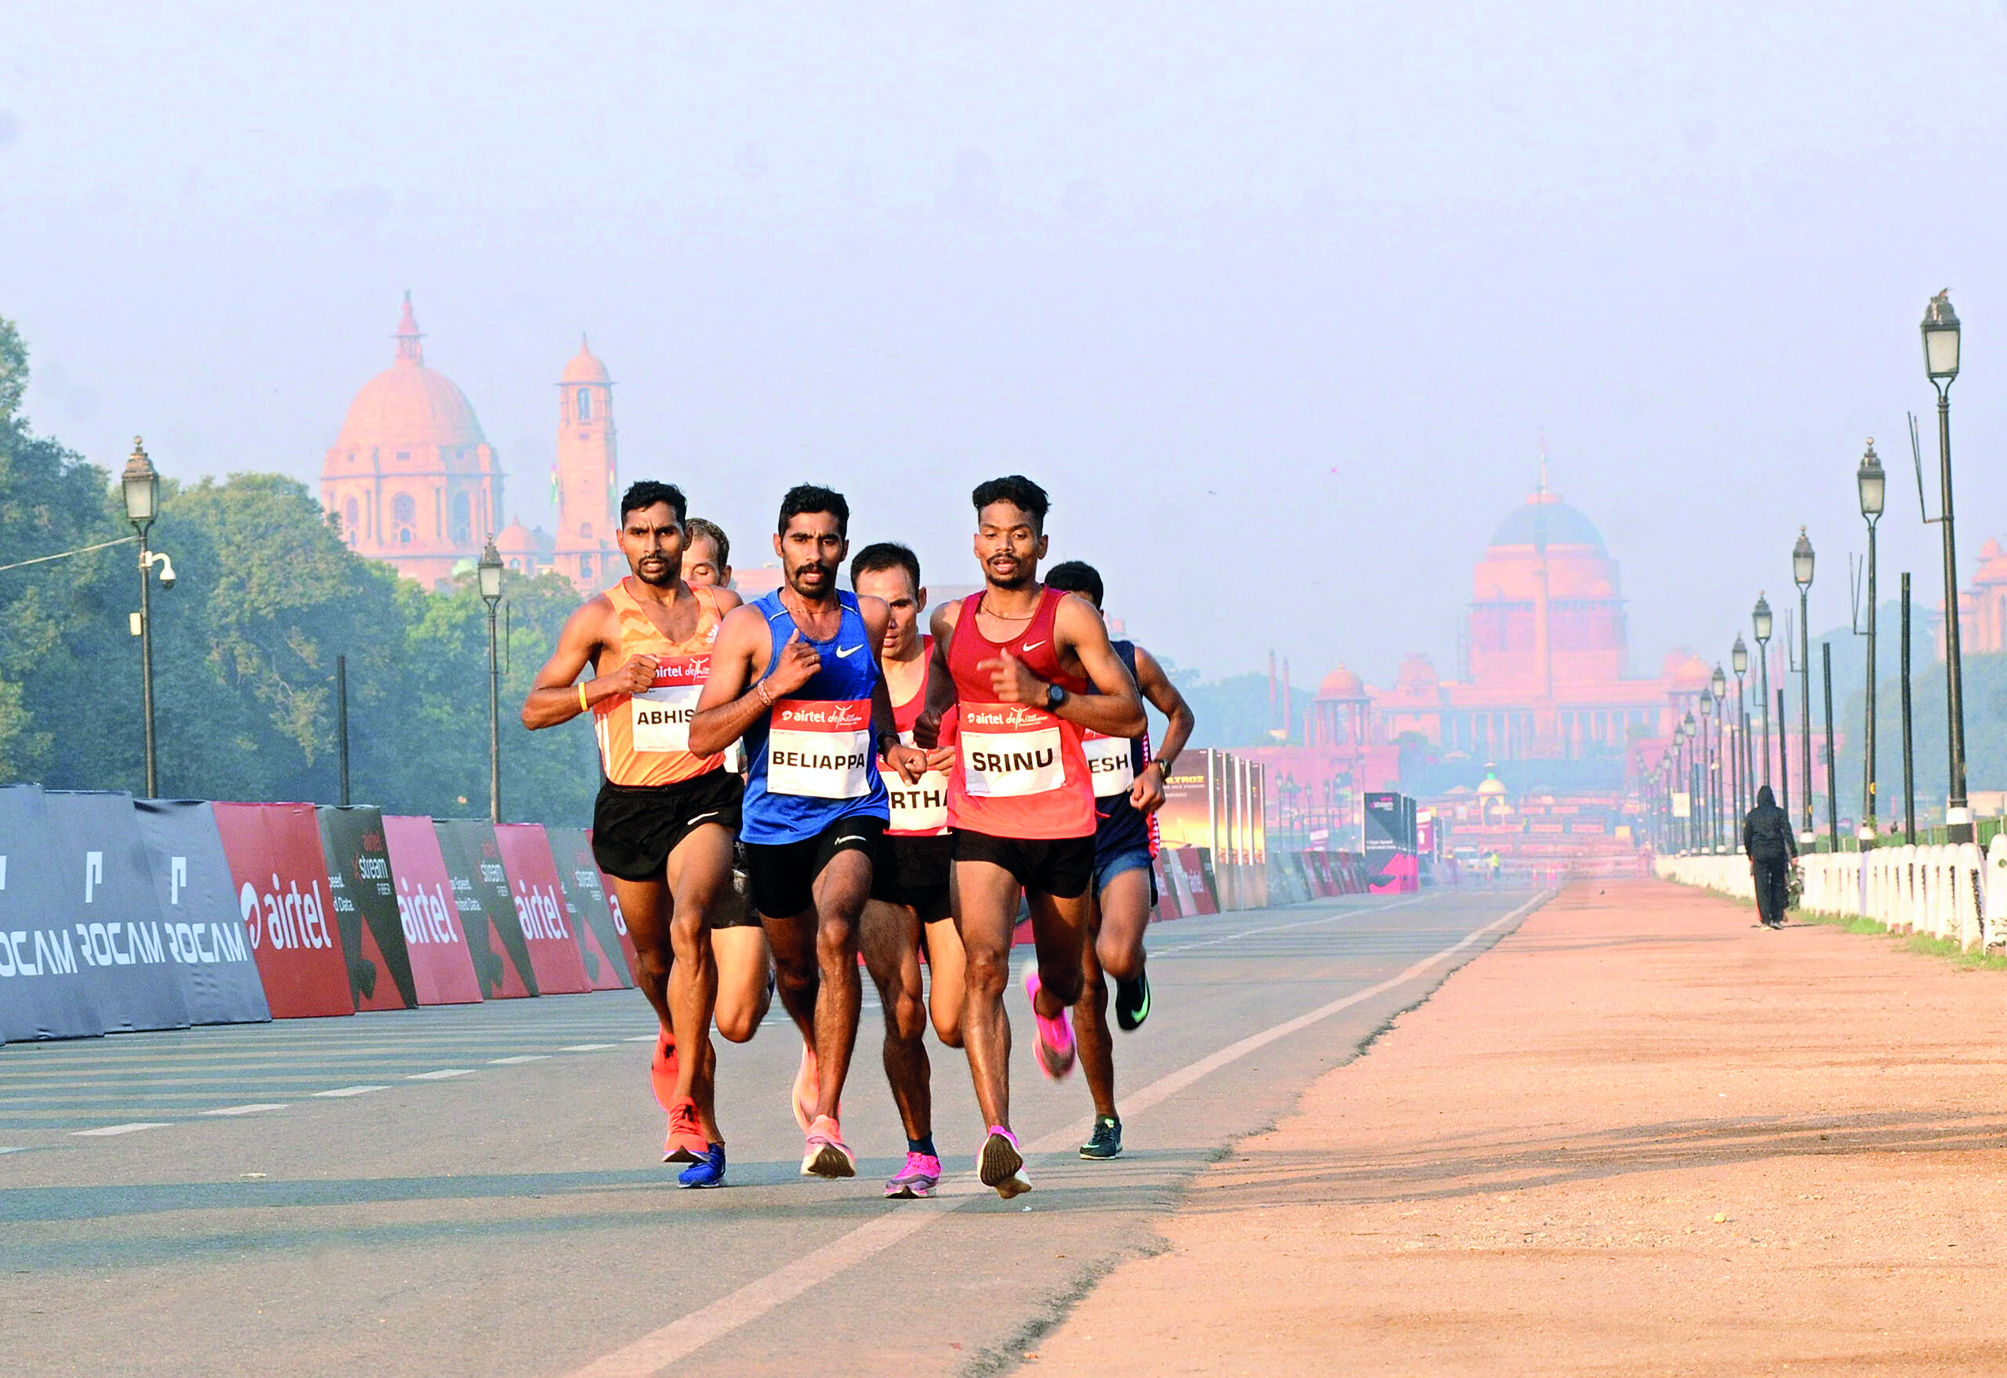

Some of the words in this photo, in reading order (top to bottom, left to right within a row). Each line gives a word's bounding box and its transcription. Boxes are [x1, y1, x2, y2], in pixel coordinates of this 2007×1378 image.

[637, 709, 695, 725] ABHIS
[793, 709, 826, 723] airtel
[976, 712, 1004, 725] airtel
[772, 751, 865, 771] BELIAPPA
[972, 748, 1053, 772] SRINU
[1088, 754, 1129, 774] ESH
[263, 872, 333, 950] airtel
[397, 876, 459, 944] airtel
[514, 879, 569, 940] airtel
[75, 921, 165, 967] ROCAM
[163, 921, 249, 963] ROCAM
